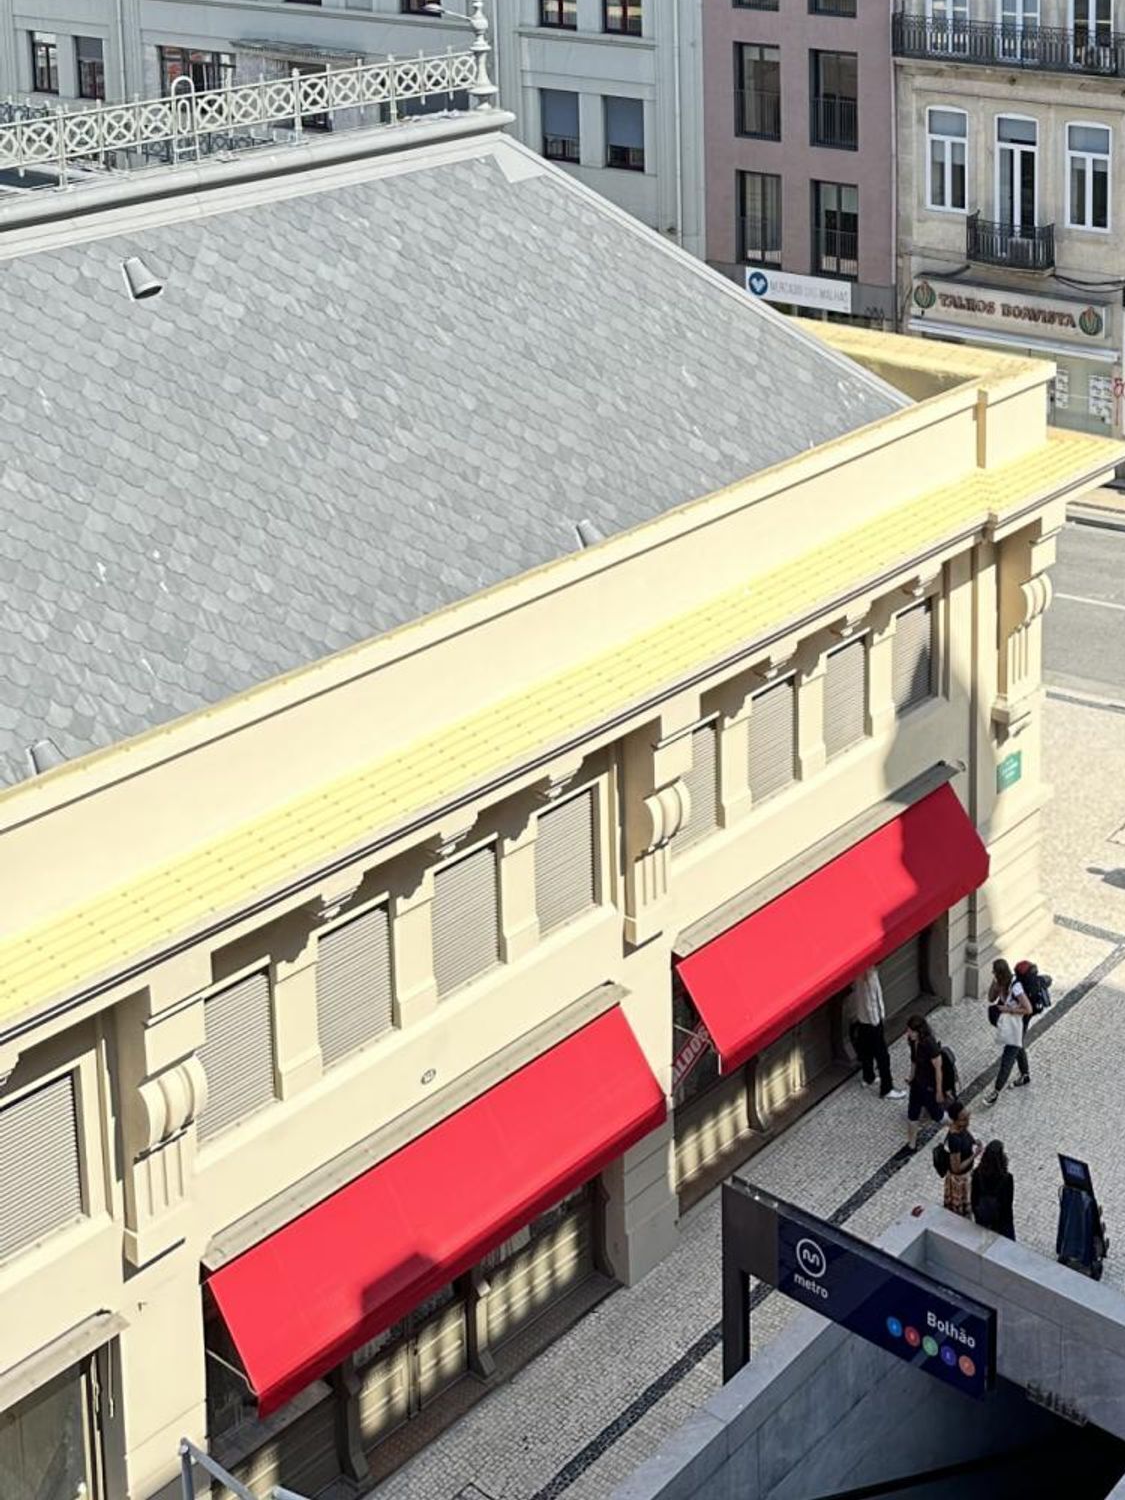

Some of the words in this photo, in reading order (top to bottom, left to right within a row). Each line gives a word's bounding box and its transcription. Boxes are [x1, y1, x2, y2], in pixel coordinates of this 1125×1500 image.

[938, 292, 995, 314] TALHOS
[1001, 303, 1077, 328] BOAVISTA
[793, 1272, 829, 1299] metro
[926, 1311, 975, 1348] Bolhão
